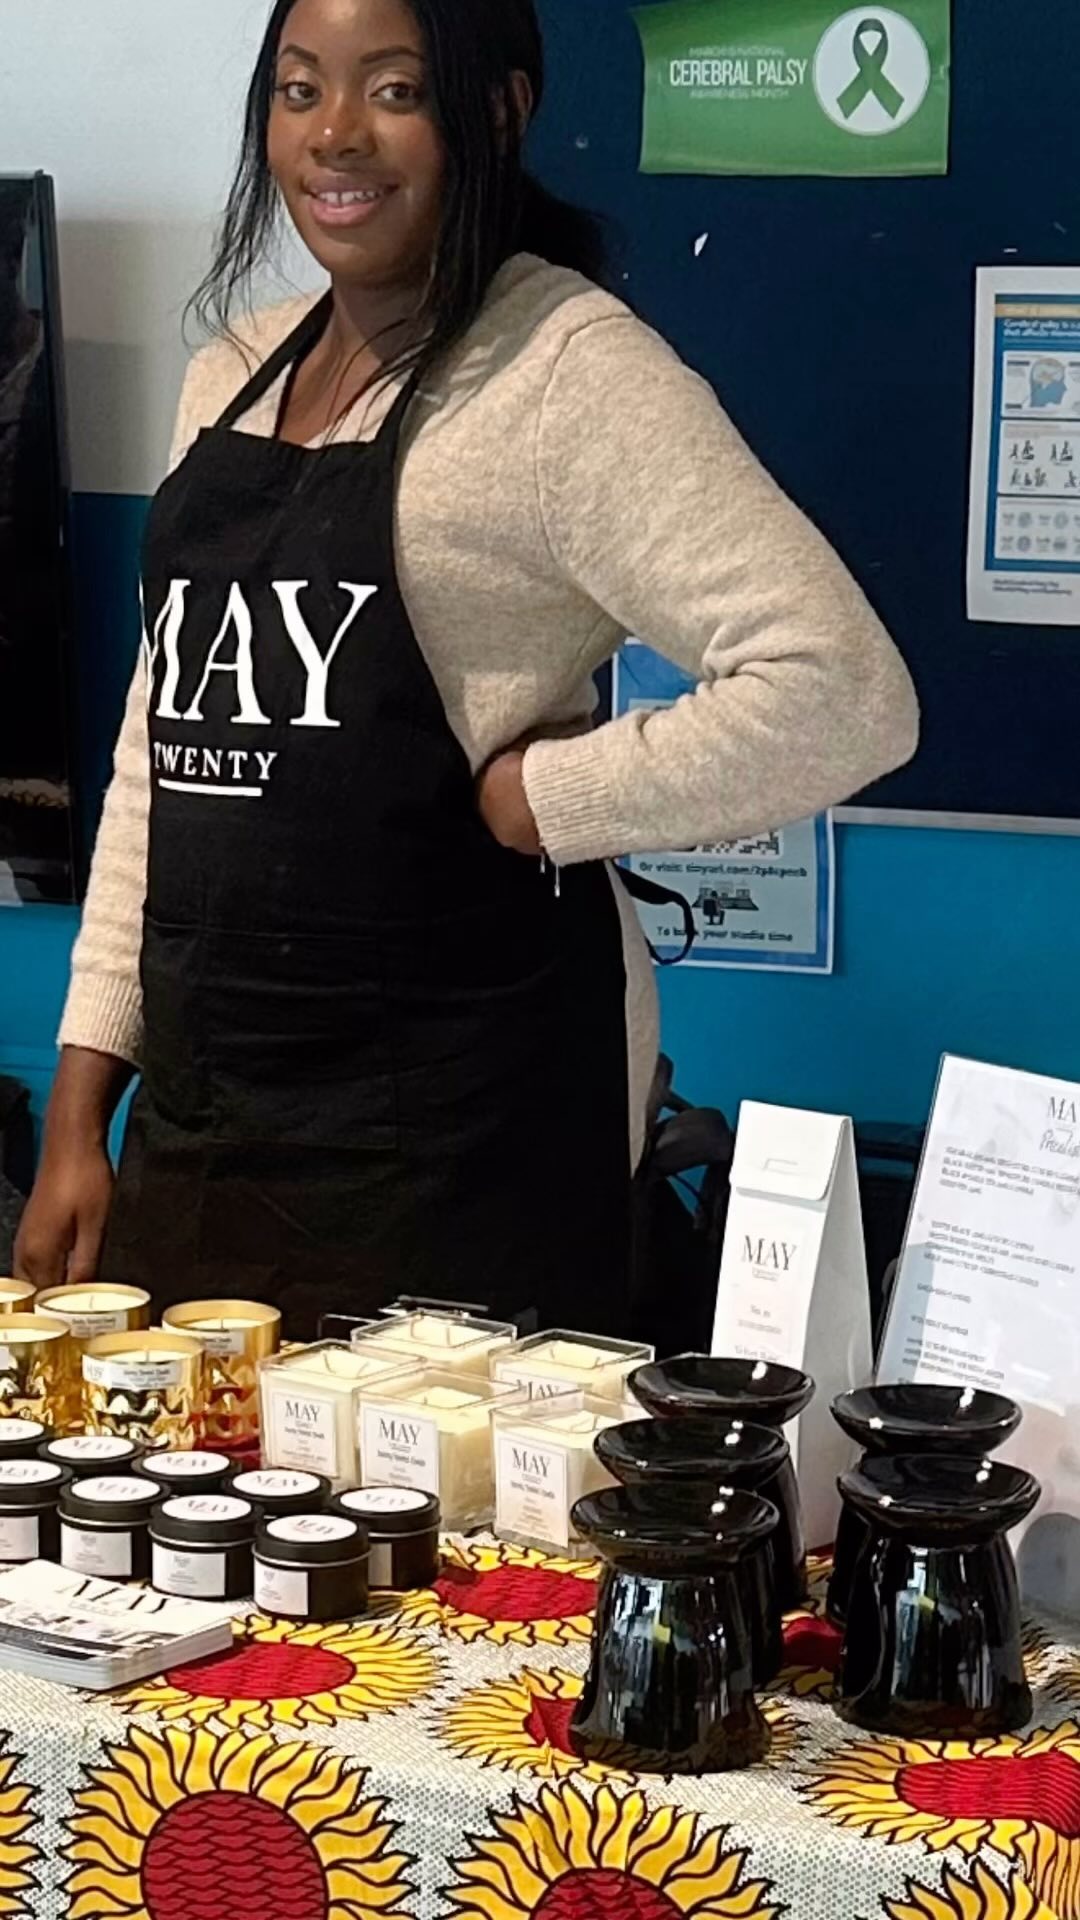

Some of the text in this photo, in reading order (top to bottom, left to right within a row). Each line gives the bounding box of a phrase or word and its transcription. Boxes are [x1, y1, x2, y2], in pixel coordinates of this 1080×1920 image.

[670, 58, 808, 86] CEREBRAL PALSY
[138, 574, 378, 728] MAY
[154, 741, 278, 781] TWENTY
[657, 926, 670, 936] To
[1046, 1096, 1080, 1123] MA
[741, 1235, 798, 1271] MAY
[285, 1400, 321, 1422] MAY
[378, 1417, 422, 1446] MAY
[512, 1447, 551, 1477] MAY
